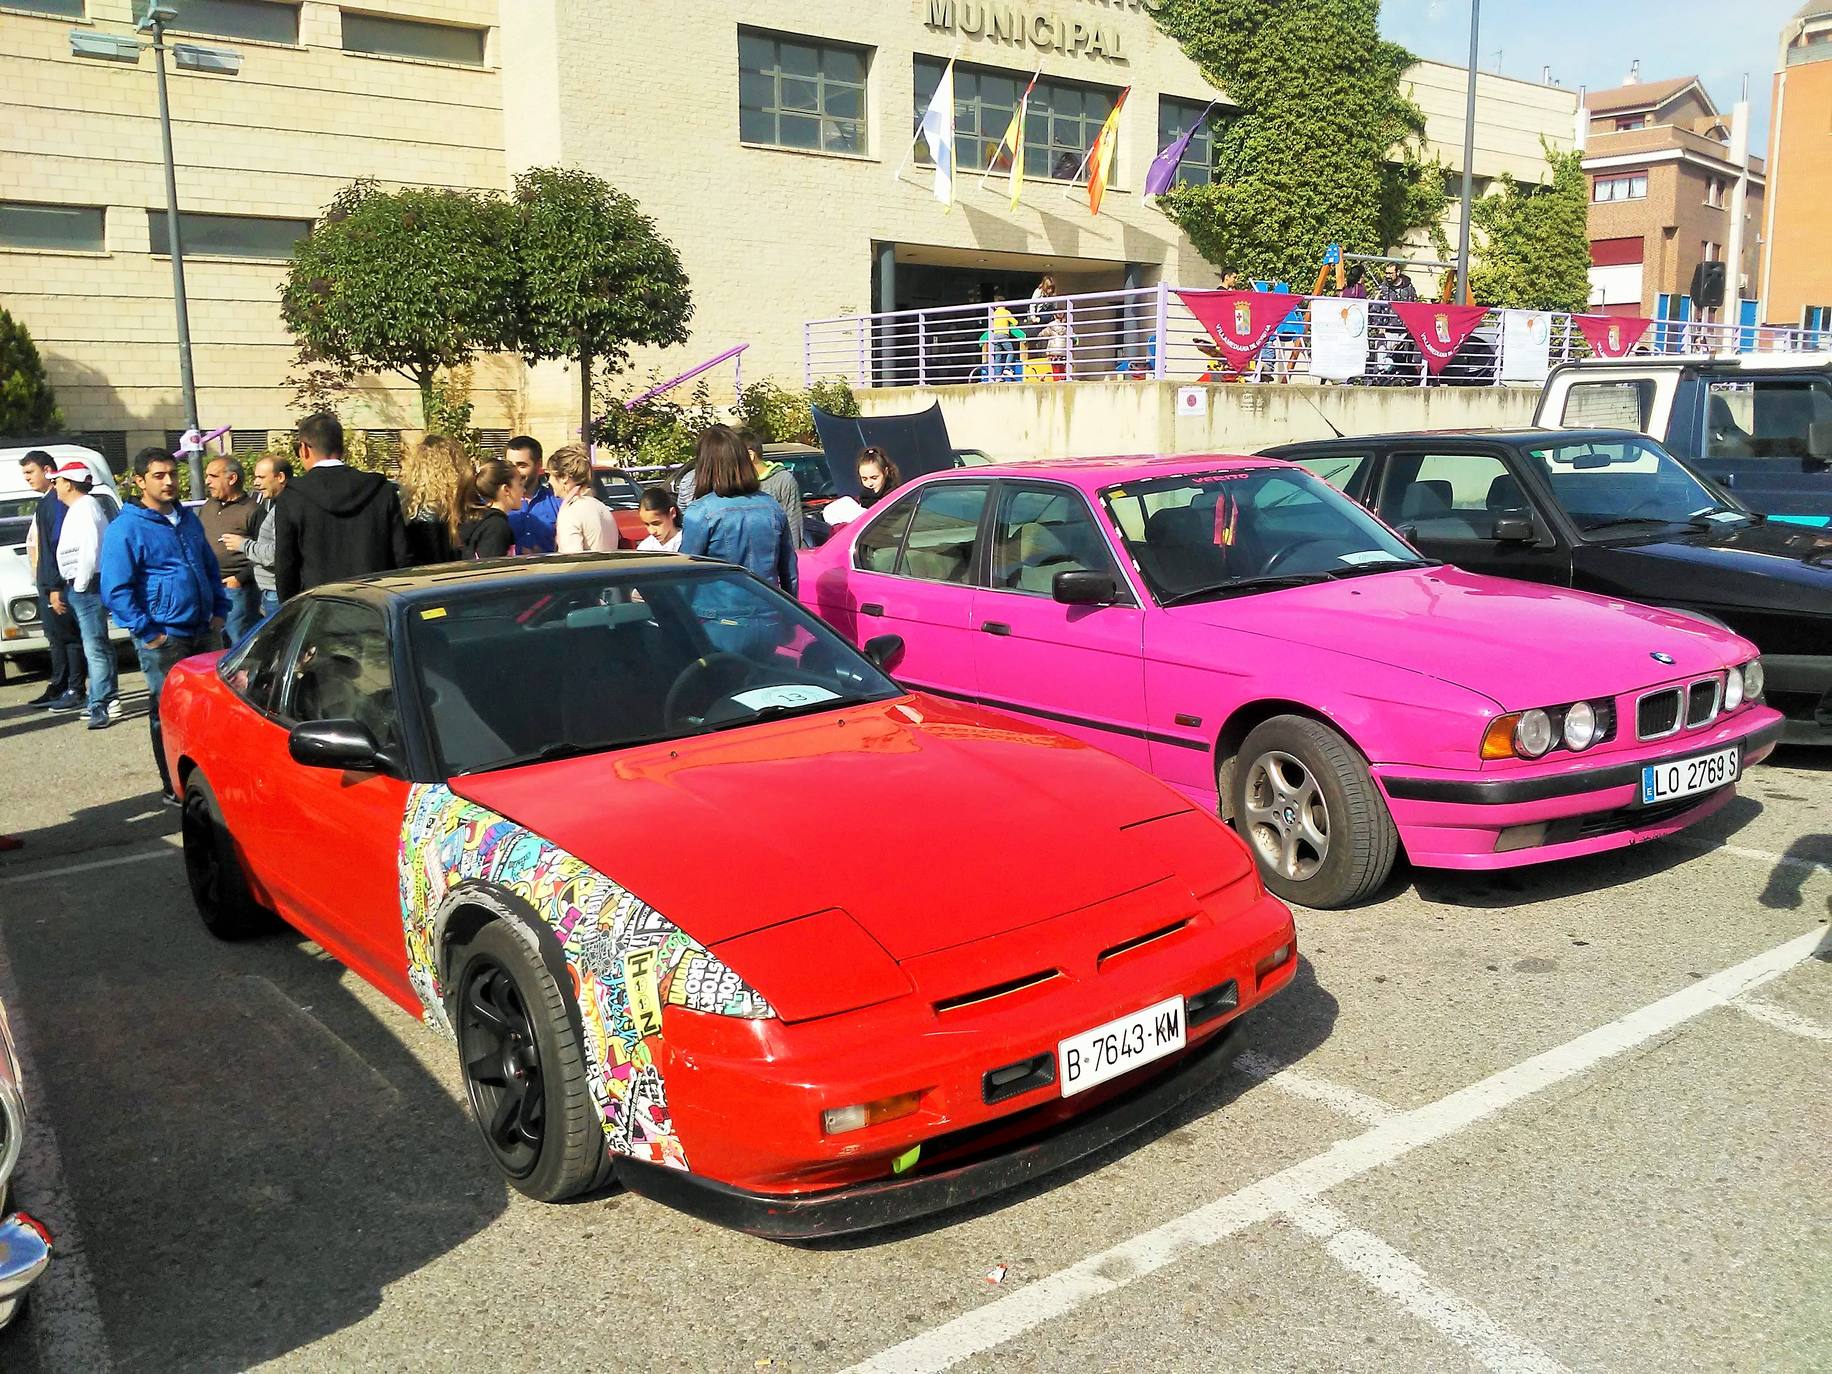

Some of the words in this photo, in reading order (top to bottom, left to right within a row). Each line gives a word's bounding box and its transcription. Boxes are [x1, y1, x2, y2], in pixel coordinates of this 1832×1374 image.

[924, 0, 1128, 60] MUNICIPAL
[1655, 766, 1680, 797] LO
[1687, 755, 1724, 790] 2769
[1728, 750, 1736, 777] S
[685, 957, 709, 995] BRO
[717, 966, 740, 1005] OOL
